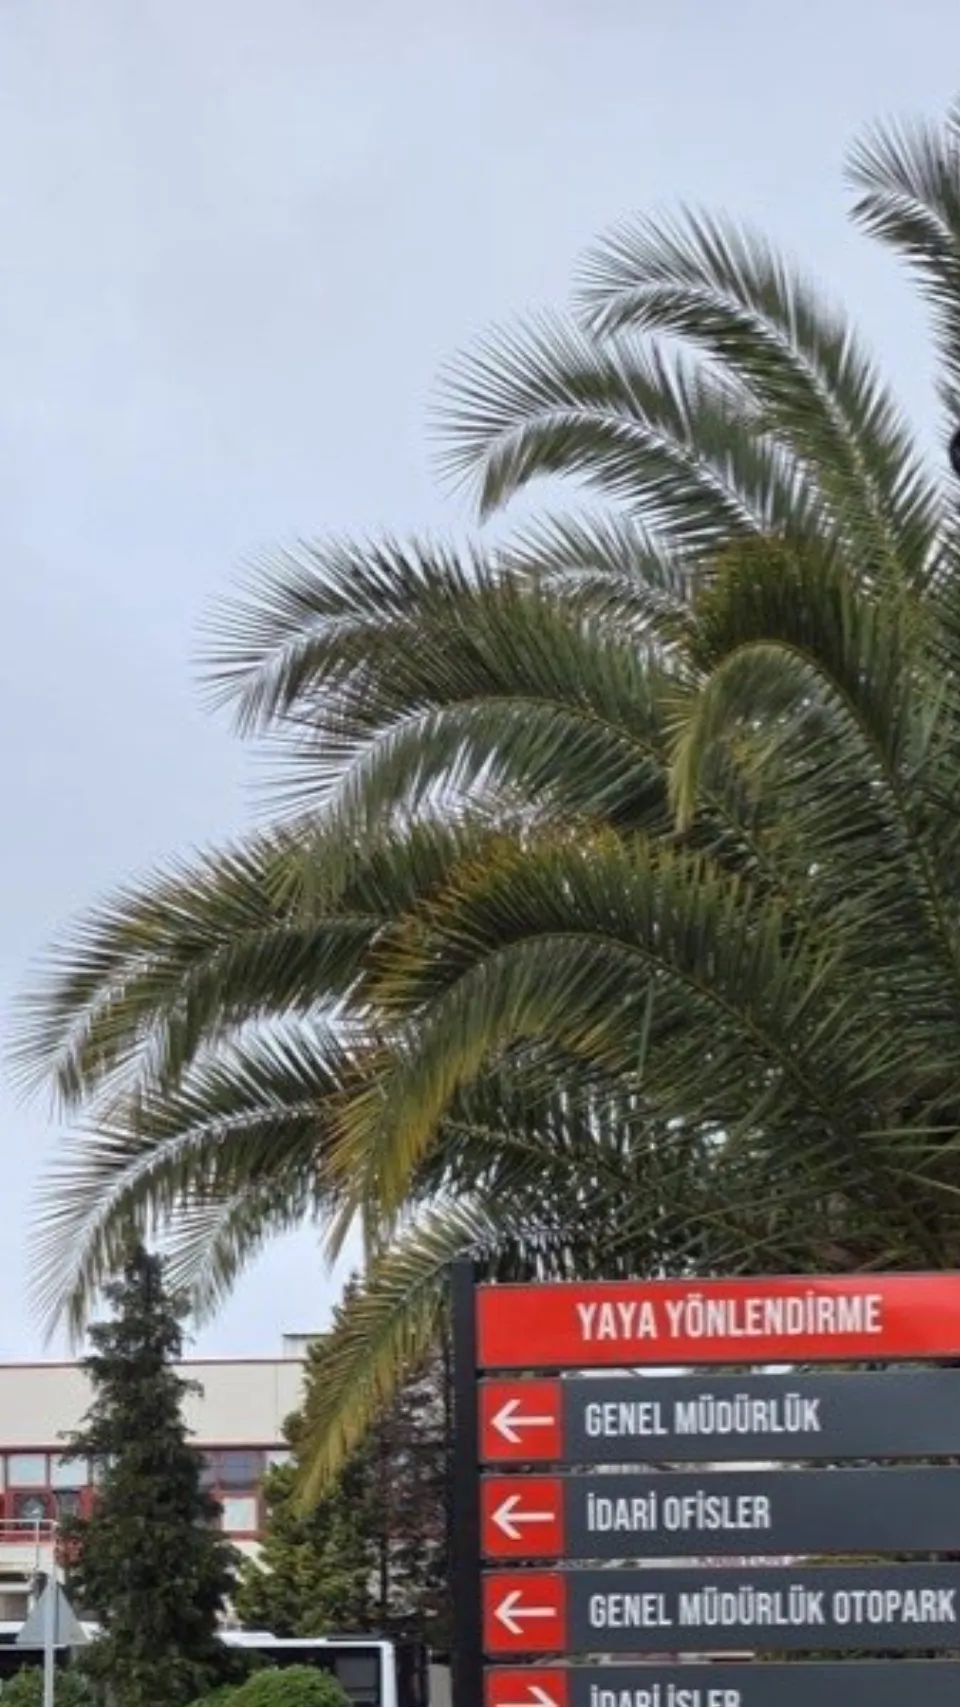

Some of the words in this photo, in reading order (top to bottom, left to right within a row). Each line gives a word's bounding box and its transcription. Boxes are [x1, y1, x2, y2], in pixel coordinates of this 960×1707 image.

[577, 1301, 658, 1341] YAYA
[664, 1290, 884, 1338] YÖNLENDİRME
[585, 1401, 668, 1437] GENEL
[674, 1392, 821, 1435] MÜDÜRLÜK
[587, 1490, 657, 1532] İDARİ
[663, 1490, 771, 1531] OFİSLER
[589, 1593, 673, 1628] GENEL
[678, 1584, 825, 1626] MÜDÜRLÜK
[832, 1589, 957, 1625] OTOPARK
